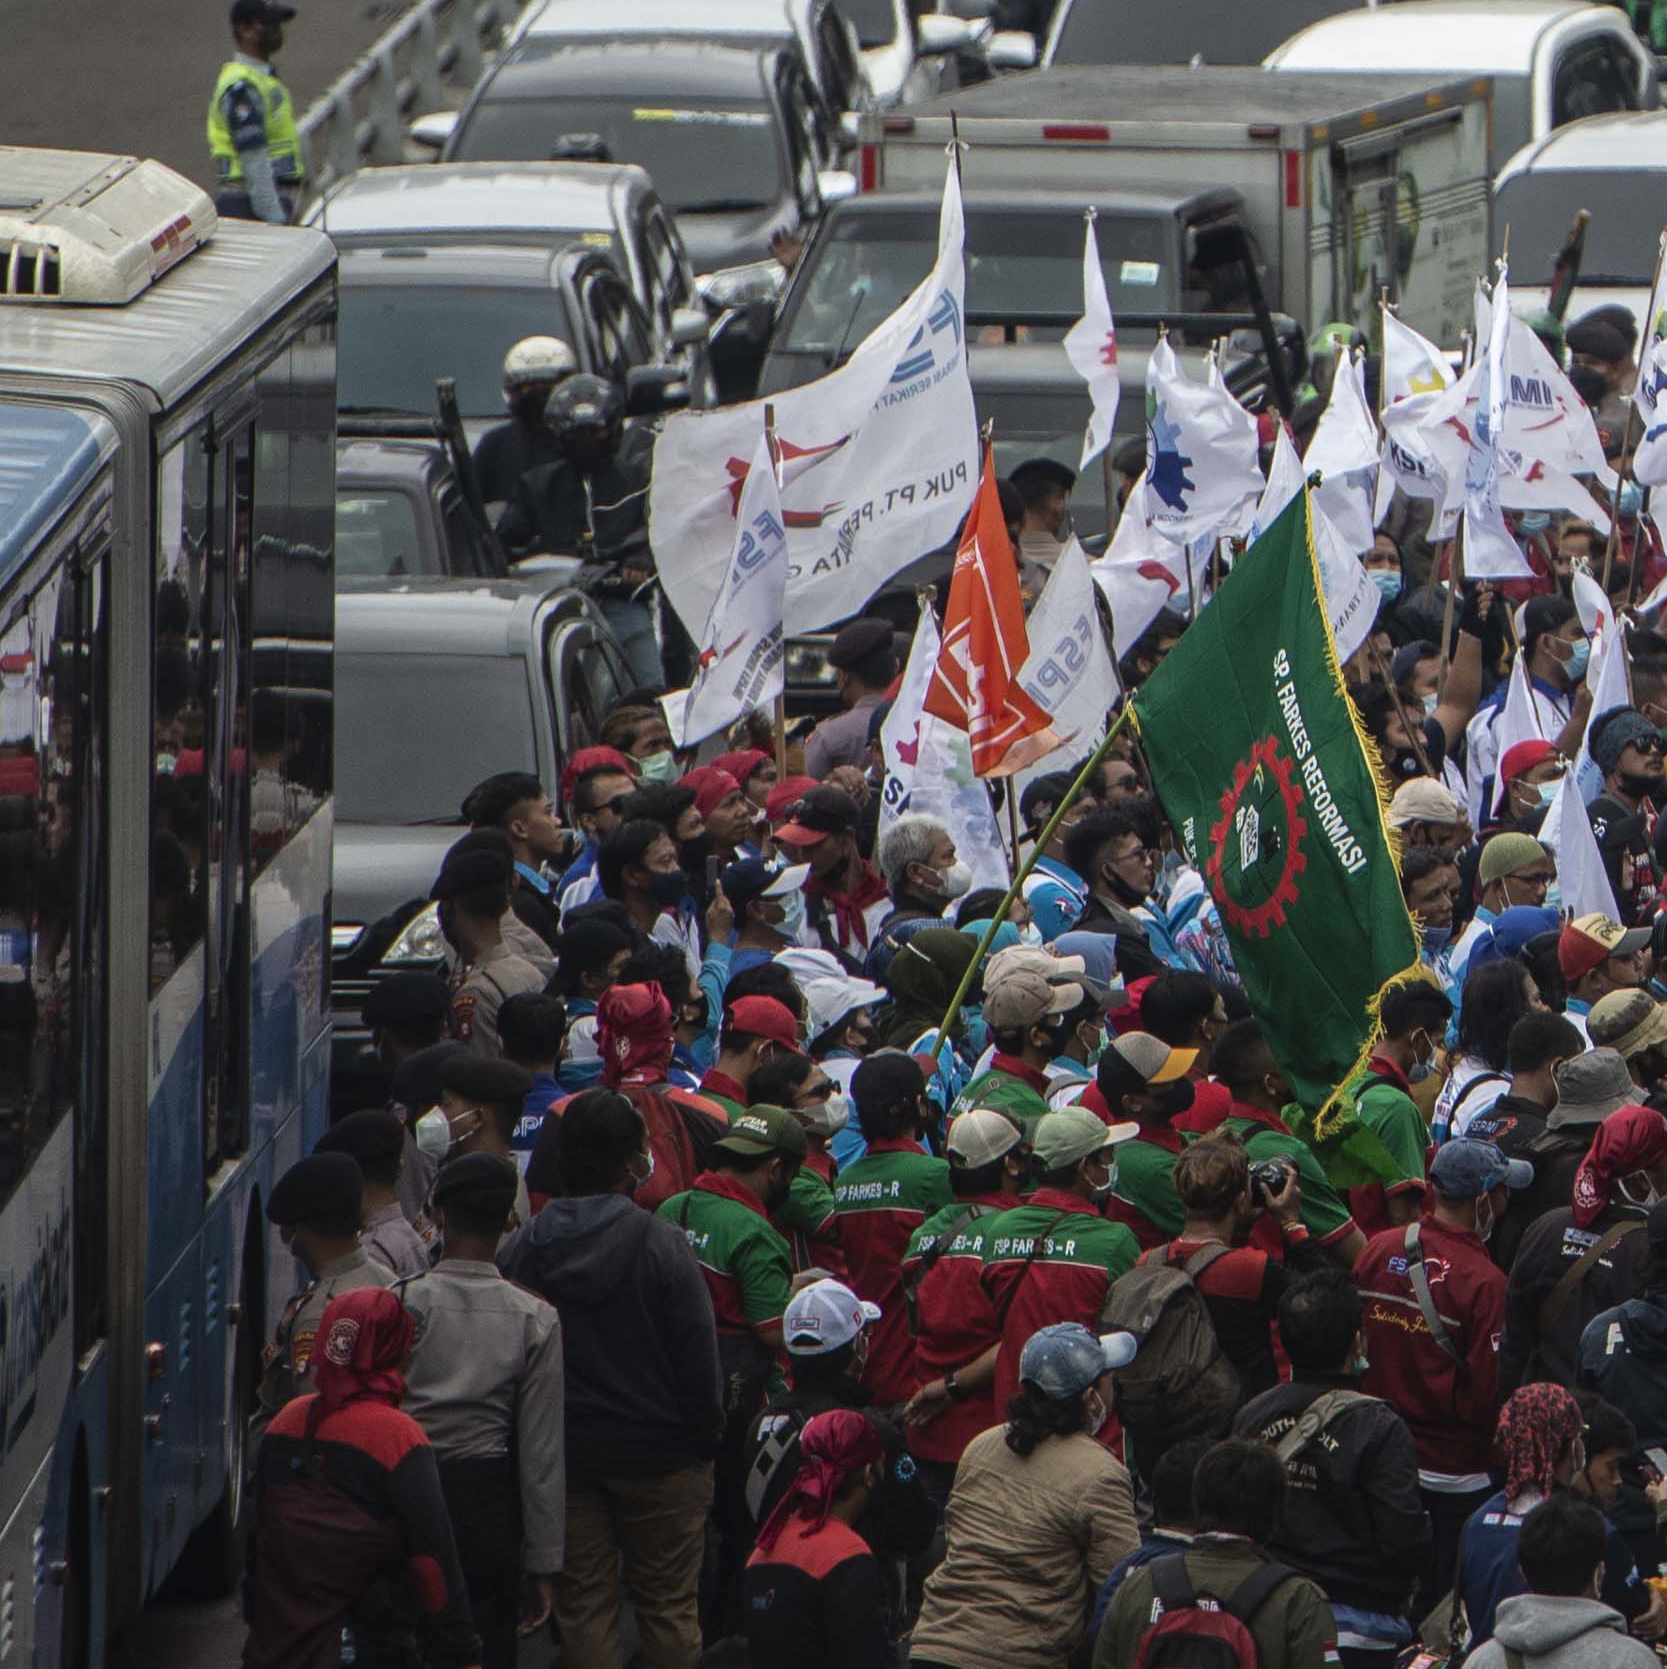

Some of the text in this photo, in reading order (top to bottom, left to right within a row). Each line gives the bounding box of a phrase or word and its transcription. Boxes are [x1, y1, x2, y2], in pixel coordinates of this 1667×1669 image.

[1271, 647, 1367, 875] SP. FARKES REFORMASI
[993, 1239, 1010, 1256] FSP
